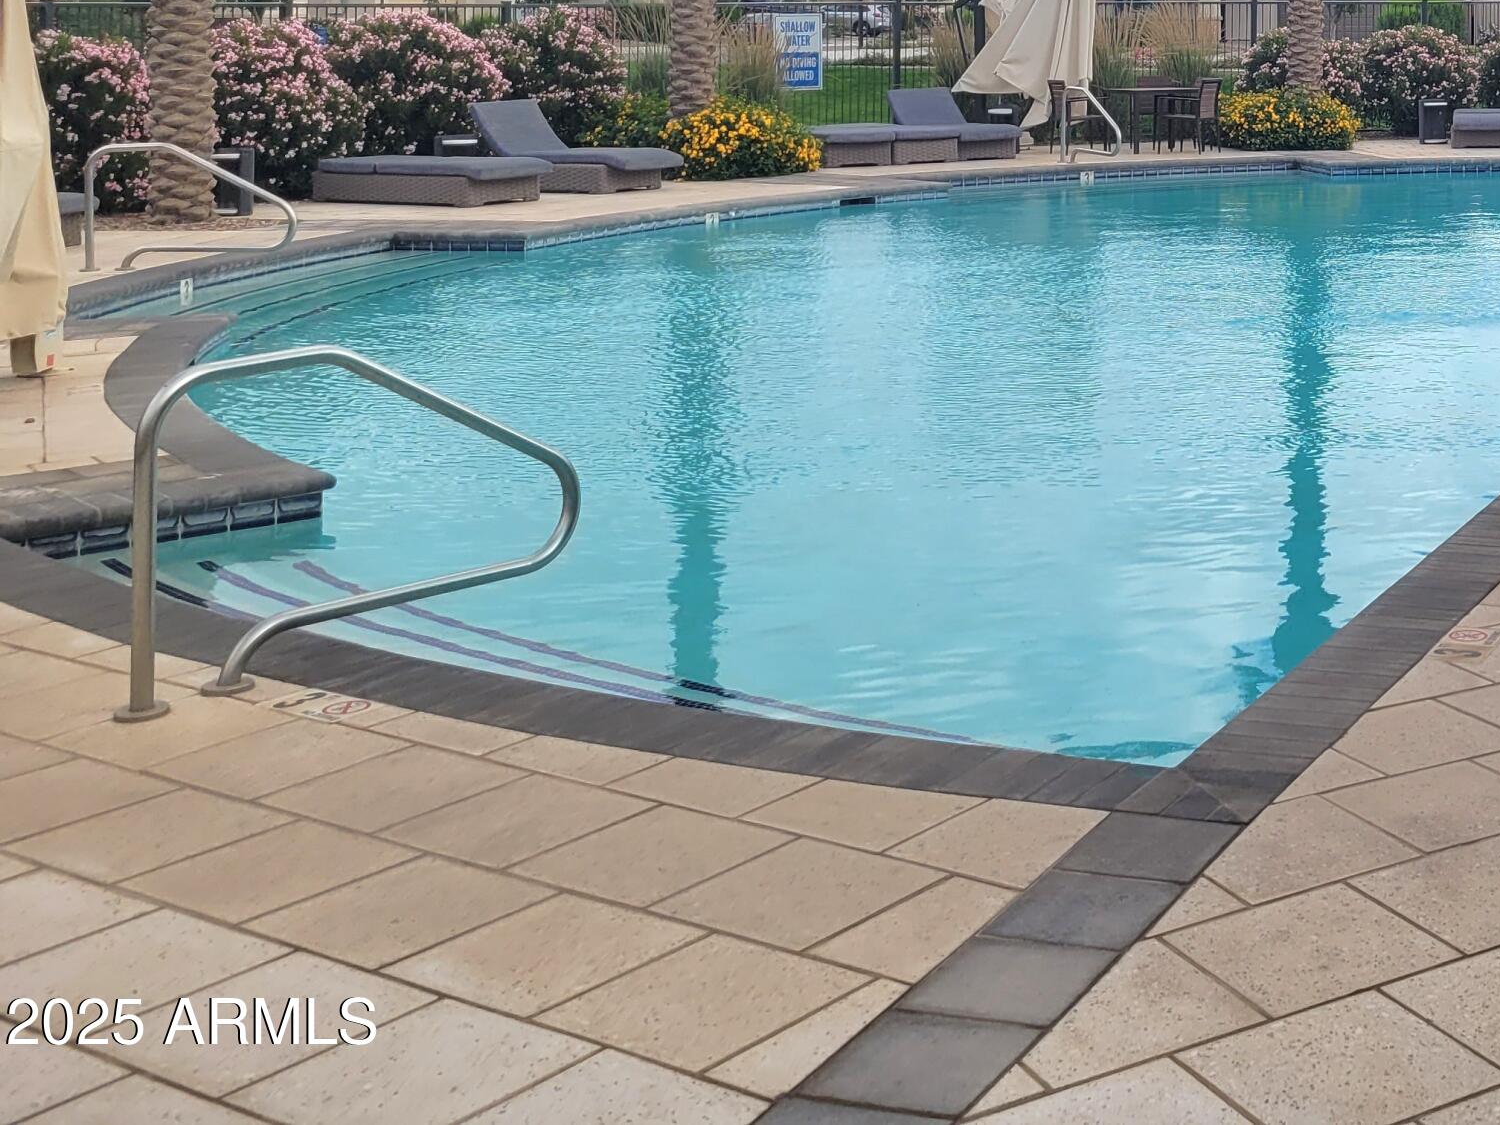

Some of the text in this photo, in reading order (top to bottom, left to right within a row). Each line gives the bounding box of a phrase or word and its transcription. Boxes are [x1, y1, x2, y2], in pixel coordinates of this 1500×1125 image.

[780, 20, 816, 33] SHALLOW
[785, 34, 811, 46] WATER
[779, 57, 817, 68] NO DIVING
[782, 71, 815, 82] ALLOWED
